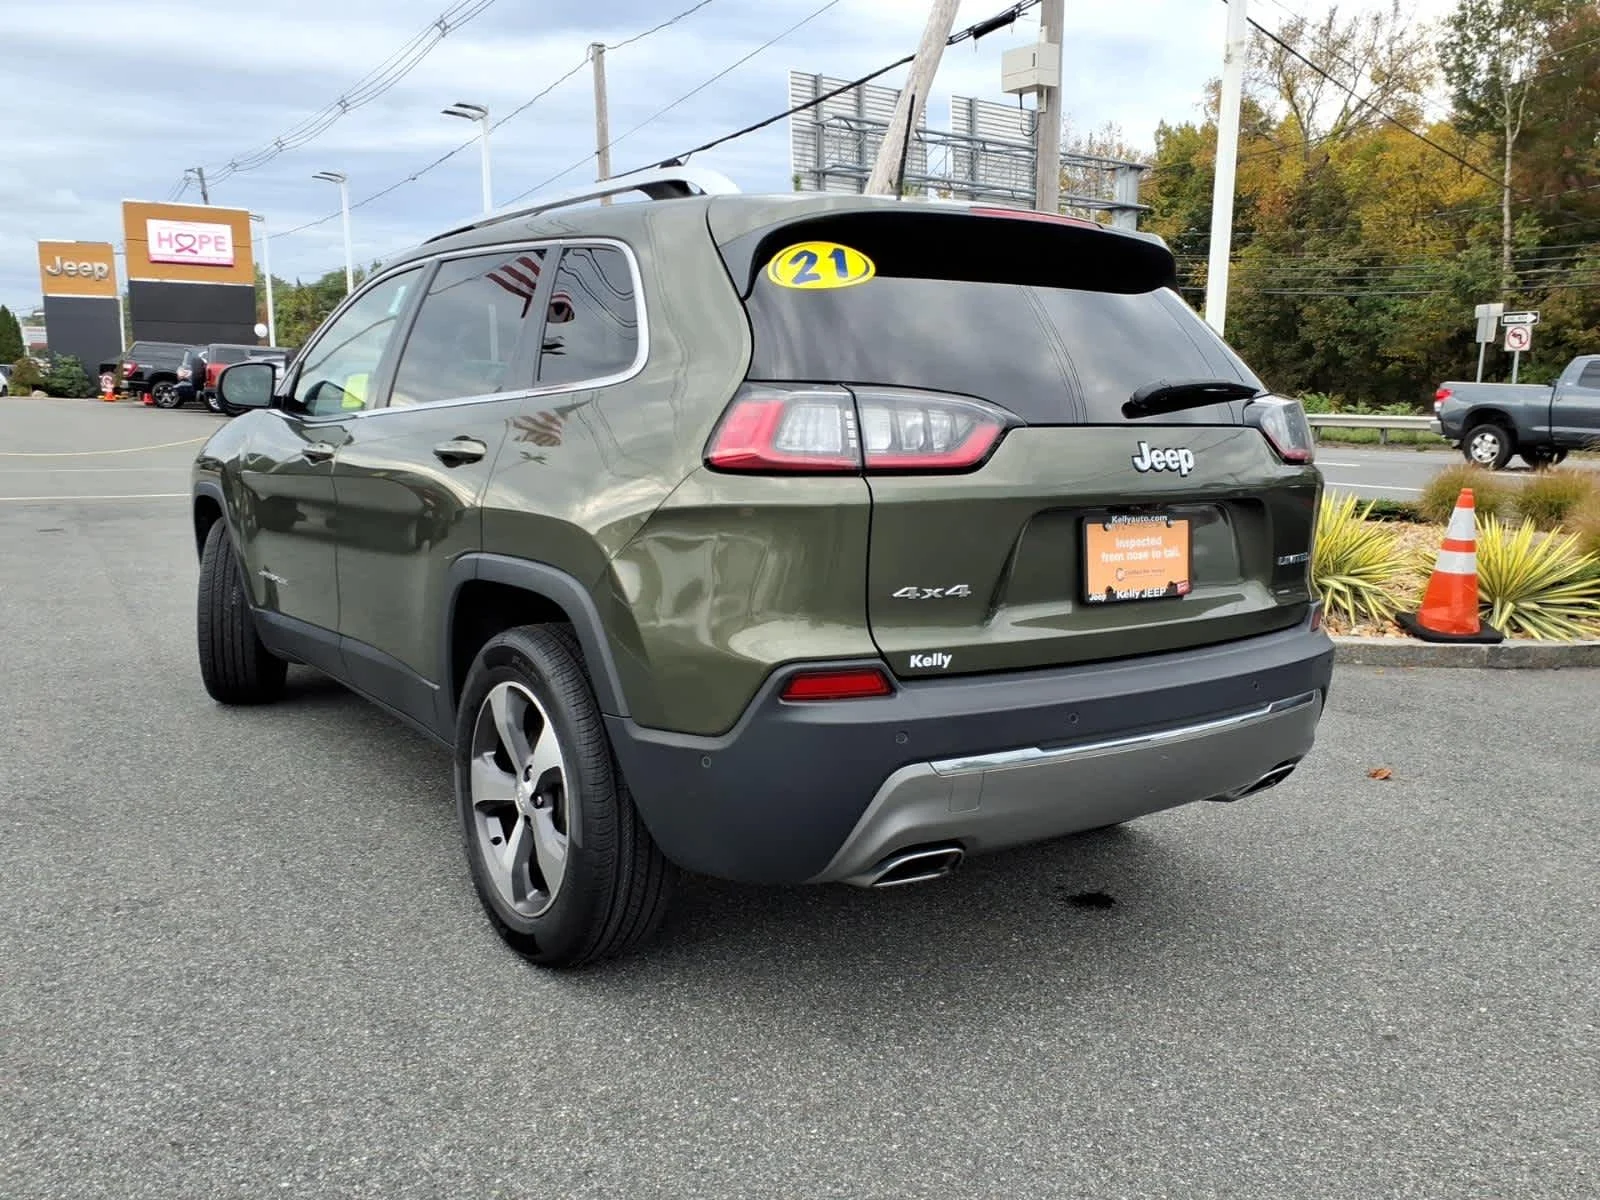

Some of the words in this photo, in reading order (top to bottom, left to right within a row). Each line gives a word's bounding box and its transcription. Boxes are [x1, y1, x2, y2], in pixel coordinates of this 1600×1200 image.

[157, 231, 227, 255] HOPE
[46, 256, 109, 281] Jeep
[788, 247, 848, 285] 21
[1132, 440, 1195, 478] Jeep
[1111, 514, 1168, 525] Kellyauto.com
[892, 584, 972, 600] 4x4
[1089, 592, 1107, 602] Jeep
[1116, 588, 1140, 599] Kelly
[1141, 586, 1167, 598] JEEP
[909, 652, 953, 669] Kelly
